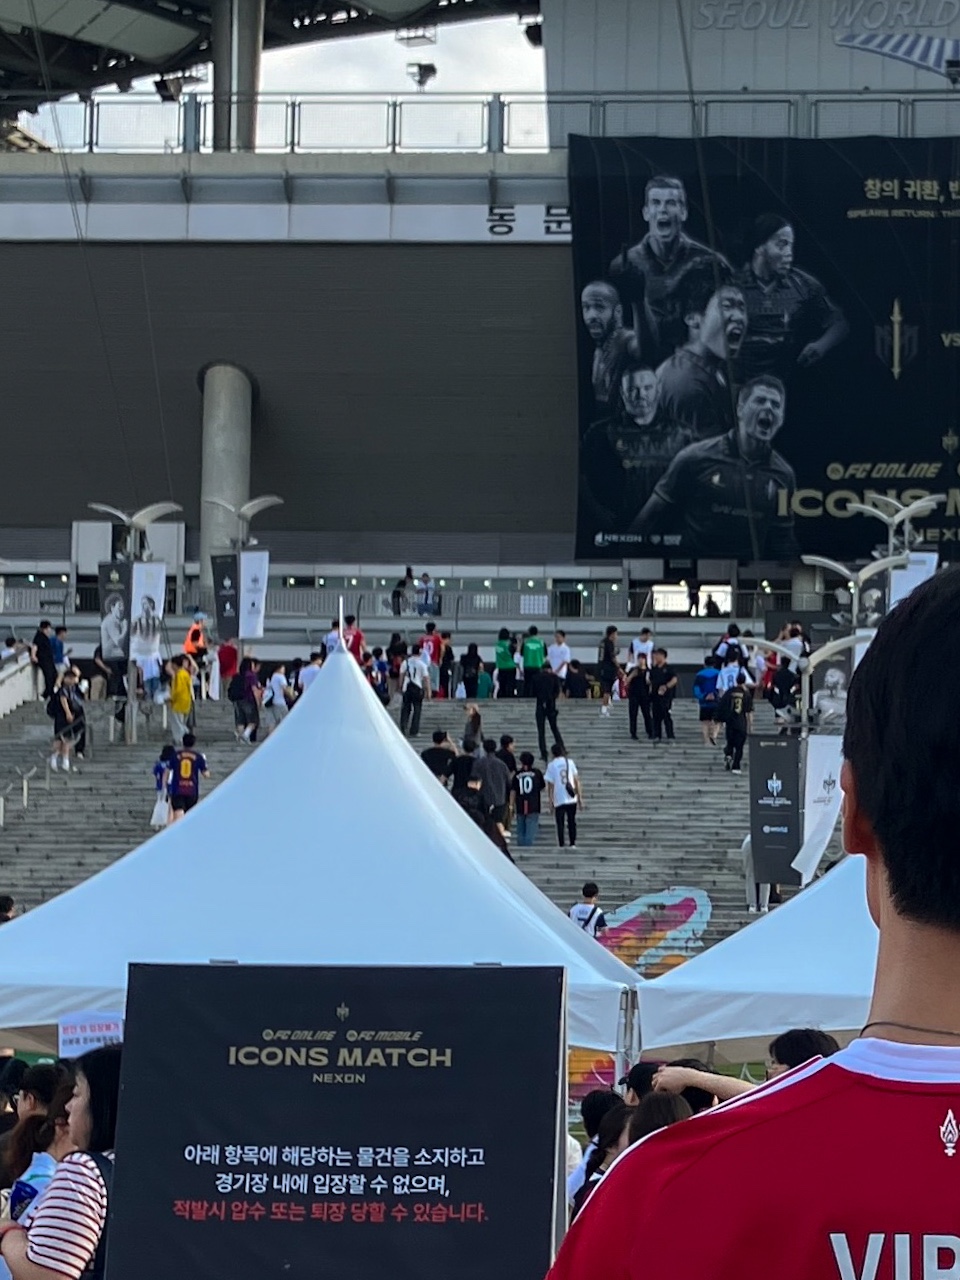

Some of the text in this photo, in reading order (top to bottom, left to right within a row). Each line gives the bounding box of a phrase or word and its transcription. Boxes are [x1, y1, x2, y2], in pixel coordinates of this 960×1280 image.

[692, 0, 811, 29] SEOUL
[828, 0, 960, 29] WORLD
[864, 178, 899, 200] 창의
[904, 178, 944, 202] 귀환,
[870, 463, 942, 479] ONLINE
[518, 776, 534, 796] 10
[229, 1046, 451, 1068] ICONS MATCH
[312, 1073, 366, 1083] NEXON
[184, 1145, 485, 1167] 아래 항목에 해당하는 물건을 소지하고
[215, 1173, 450, 1197] 경기장 내에 입장할 수 없으며,
[173, 1201, 489, 1222] 적발시 압수 또는 퇴장 당할 수 있습니다.
